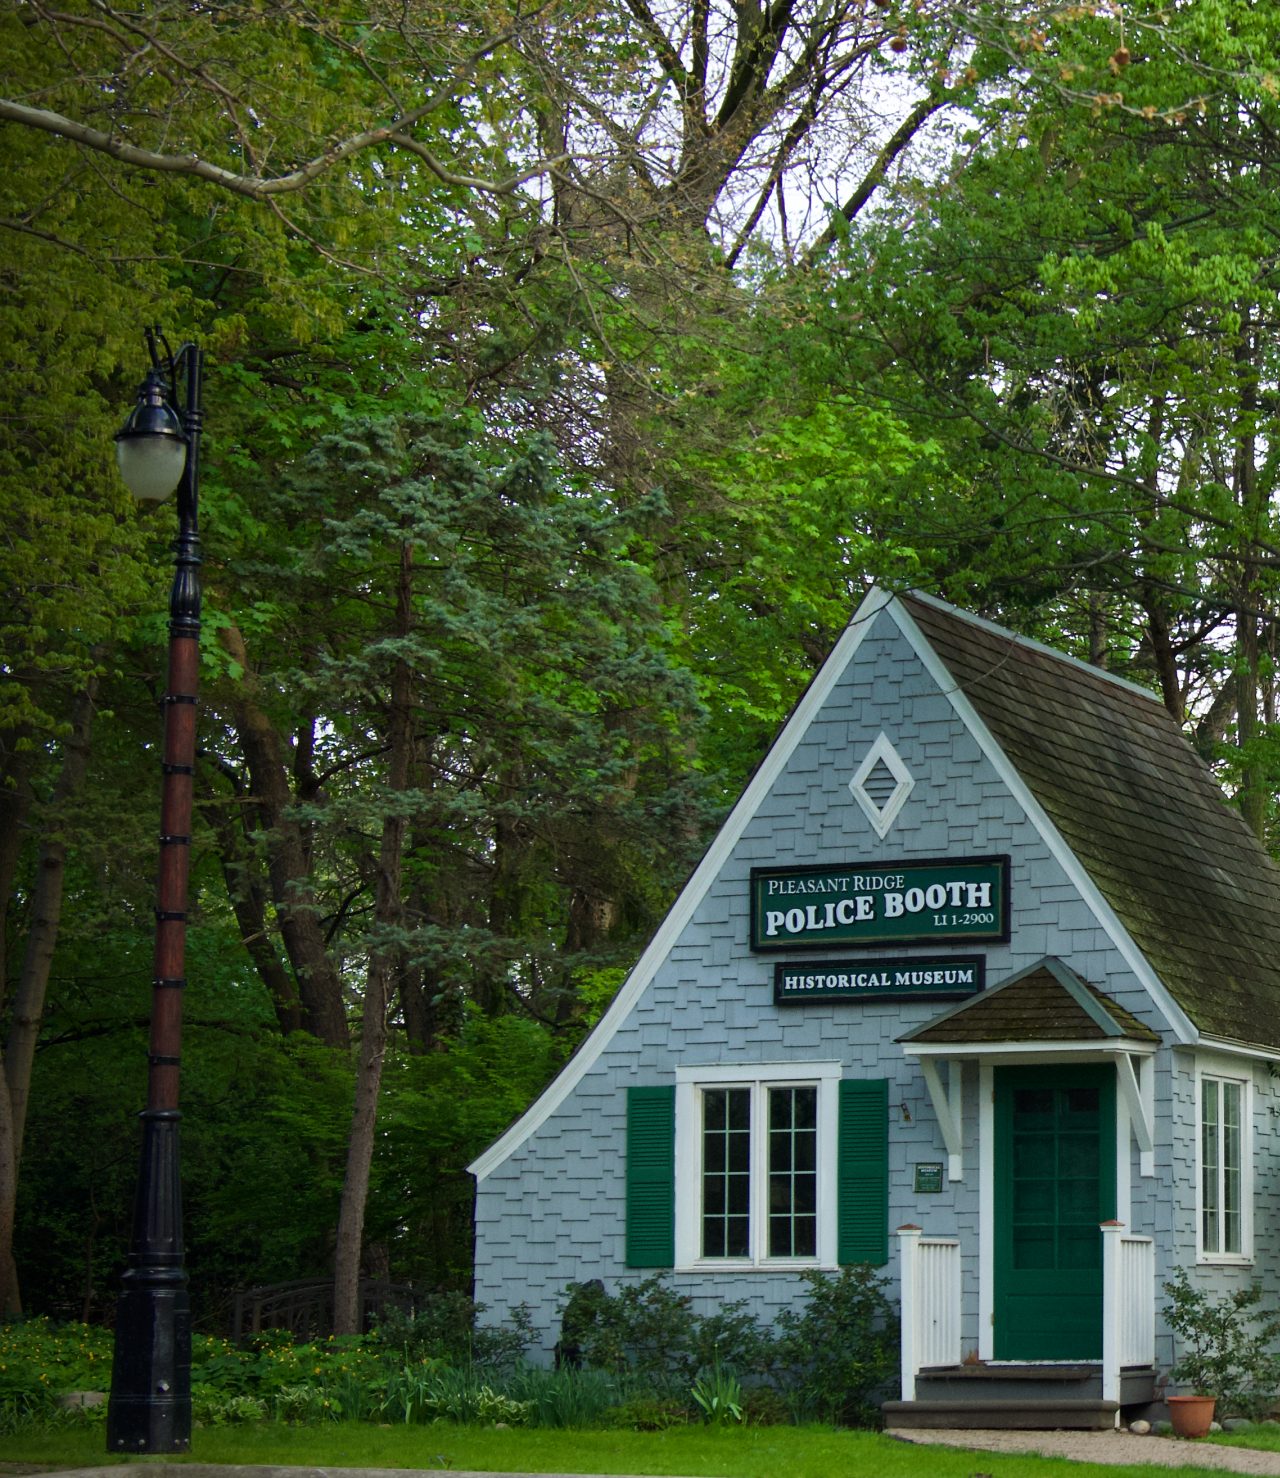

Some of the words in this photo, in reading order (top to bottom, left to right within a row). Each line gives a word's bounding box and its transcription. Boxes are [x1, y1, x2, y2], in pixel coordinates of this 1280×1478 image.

[768, 878, 849, 895] PLEASANT
[853, 875, 905, 891] RIDGE
[766, 895, 874, 935] POLICE
[884, 882, 991, 918] BOOTH
[784, 973, 891, 990] HISTORICAL
[895, 970, 973, 986] MUSEUM
